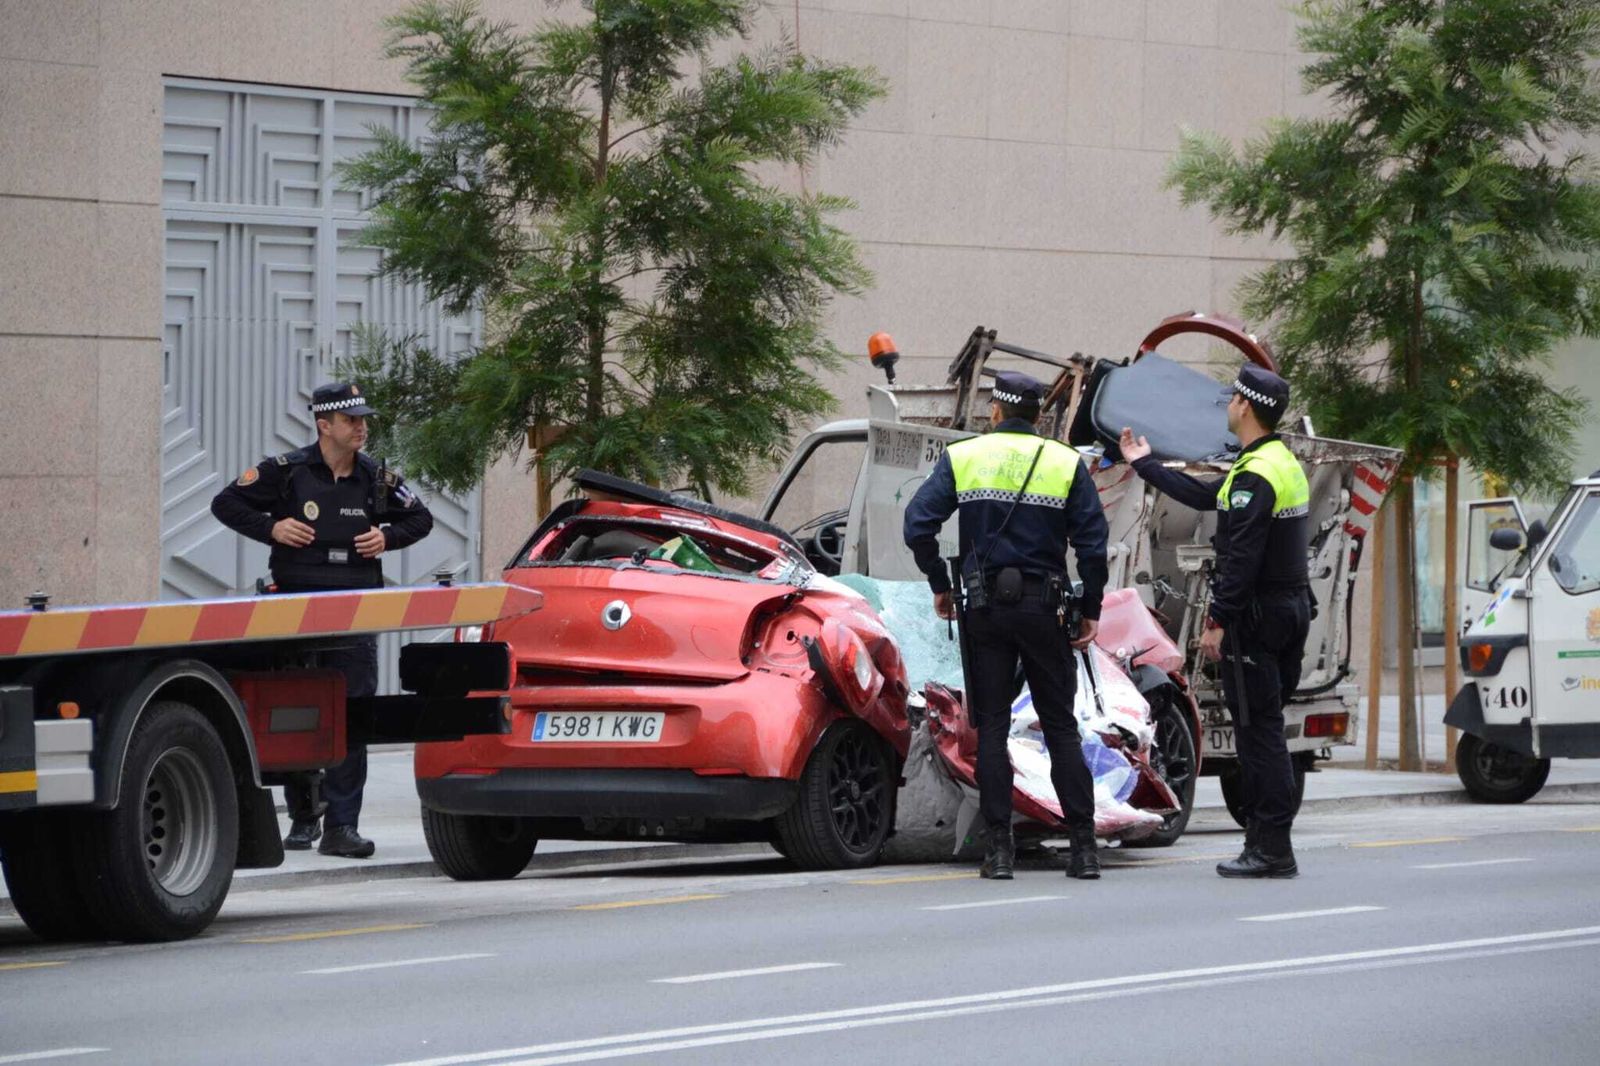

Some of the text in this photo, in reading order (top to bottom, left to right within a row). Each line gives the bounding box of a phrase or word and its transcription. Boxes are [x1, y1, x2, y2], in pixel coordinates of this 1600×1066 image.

[977, 467, 1044, 482] GRANAA
[340, 508, 366, 517] POLICIA
[1483, 686, 1528, 708] 740
[549, 716, 604, 737] 5981
[612, 716, 656, 737] KWG
